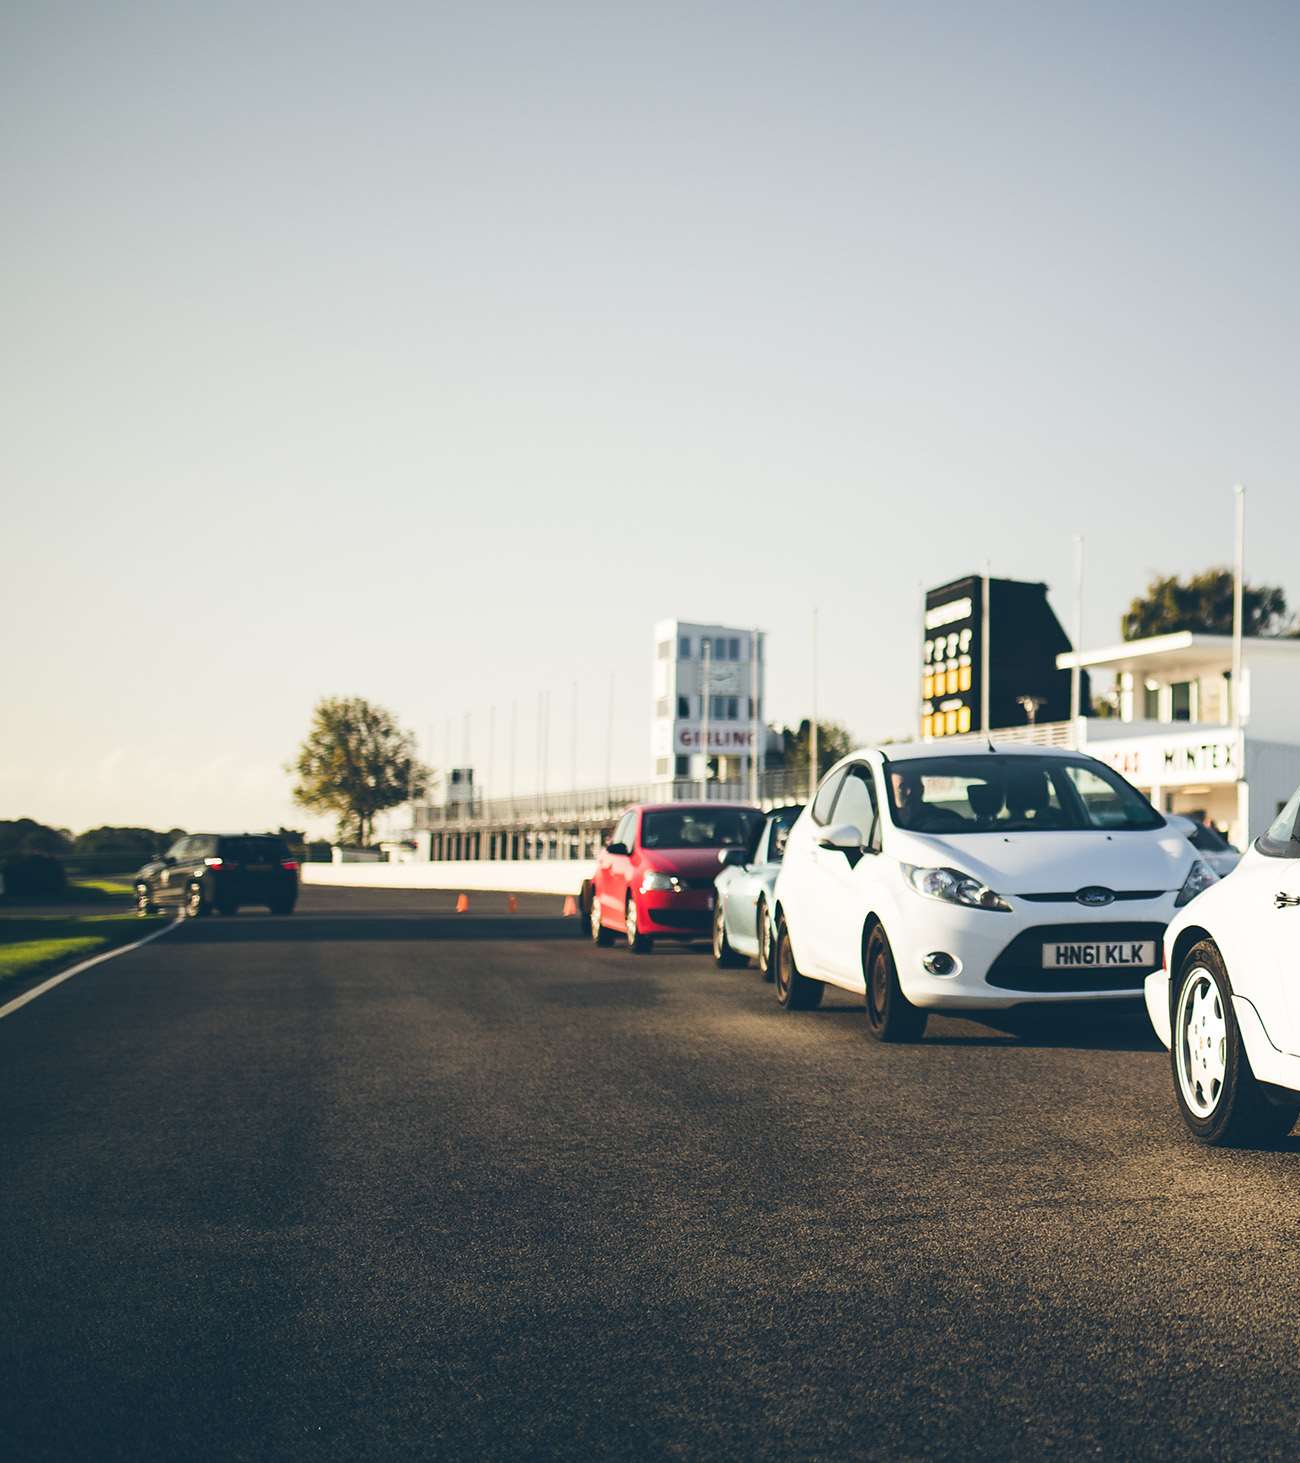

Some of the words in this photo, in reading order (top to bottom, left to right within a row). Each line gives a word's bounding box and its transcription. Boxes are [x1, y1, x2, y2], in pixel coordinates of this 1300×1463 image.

[680, 730, 758, 746] GILIN
[1163, 742, 1237, 773] MINTEX
[1056, 945, 1100, 965] HN61
[1106, 944, 1143, 964] KLK
